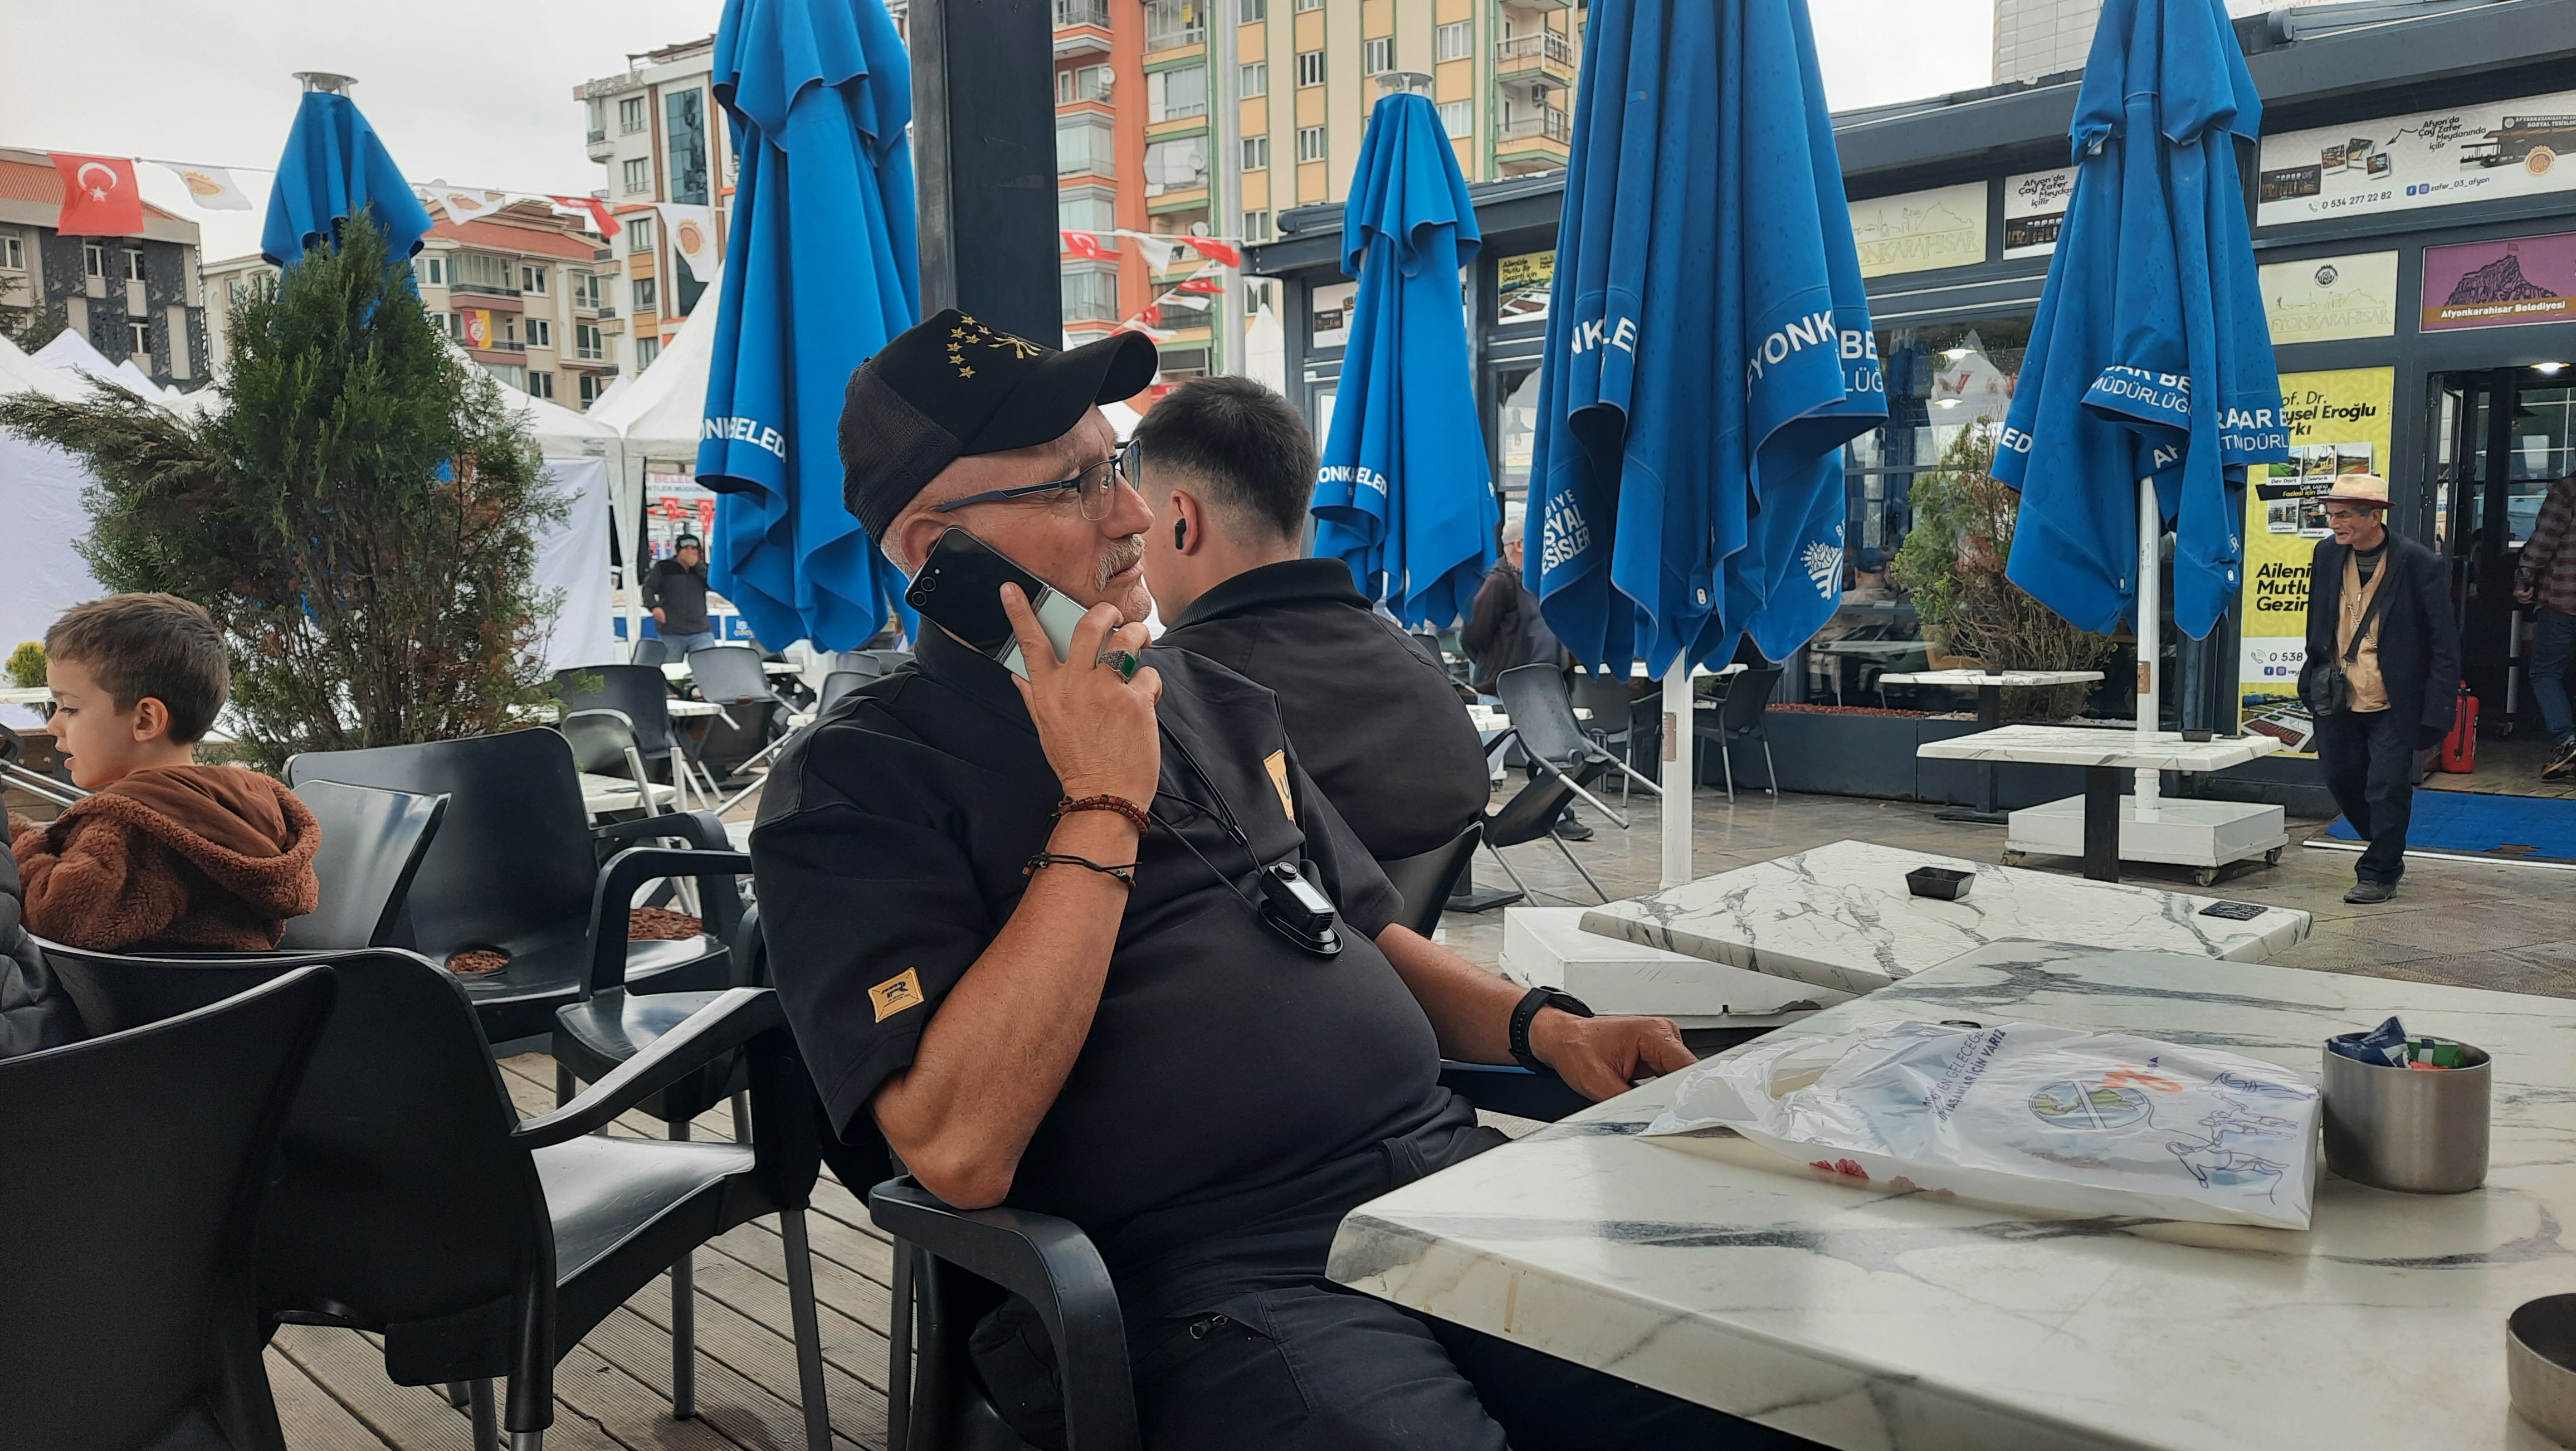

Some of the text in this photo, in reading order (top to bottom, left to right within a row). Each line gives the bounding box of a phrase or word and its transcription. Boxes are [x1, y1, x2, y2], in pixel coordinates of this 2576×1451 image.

[2423, 116, 2460, 129] Afyon'da
[2418, 124, 2462, 139] Çay Zafer
[2437, 126, 2486, 142] Meydanında
[2429, 142, 2445, 152] İçilir
[2023, 174, 2065, 187] Afyon'da
[2018, 181, 2068, 197] Çay Zafer
[2322, 191, 2392, 210] 0 534 277 22 82
[2441, 300, 2565, 319] Afyonkarahisar Belediyesi
[2306, 391, 2327, 405] Dr.
[2322, 402, 2377, 422] Eroğlu
[2270, 652, 2303, 661] 0 538
[1980, 1028, 2006, 1057] VARIZ
